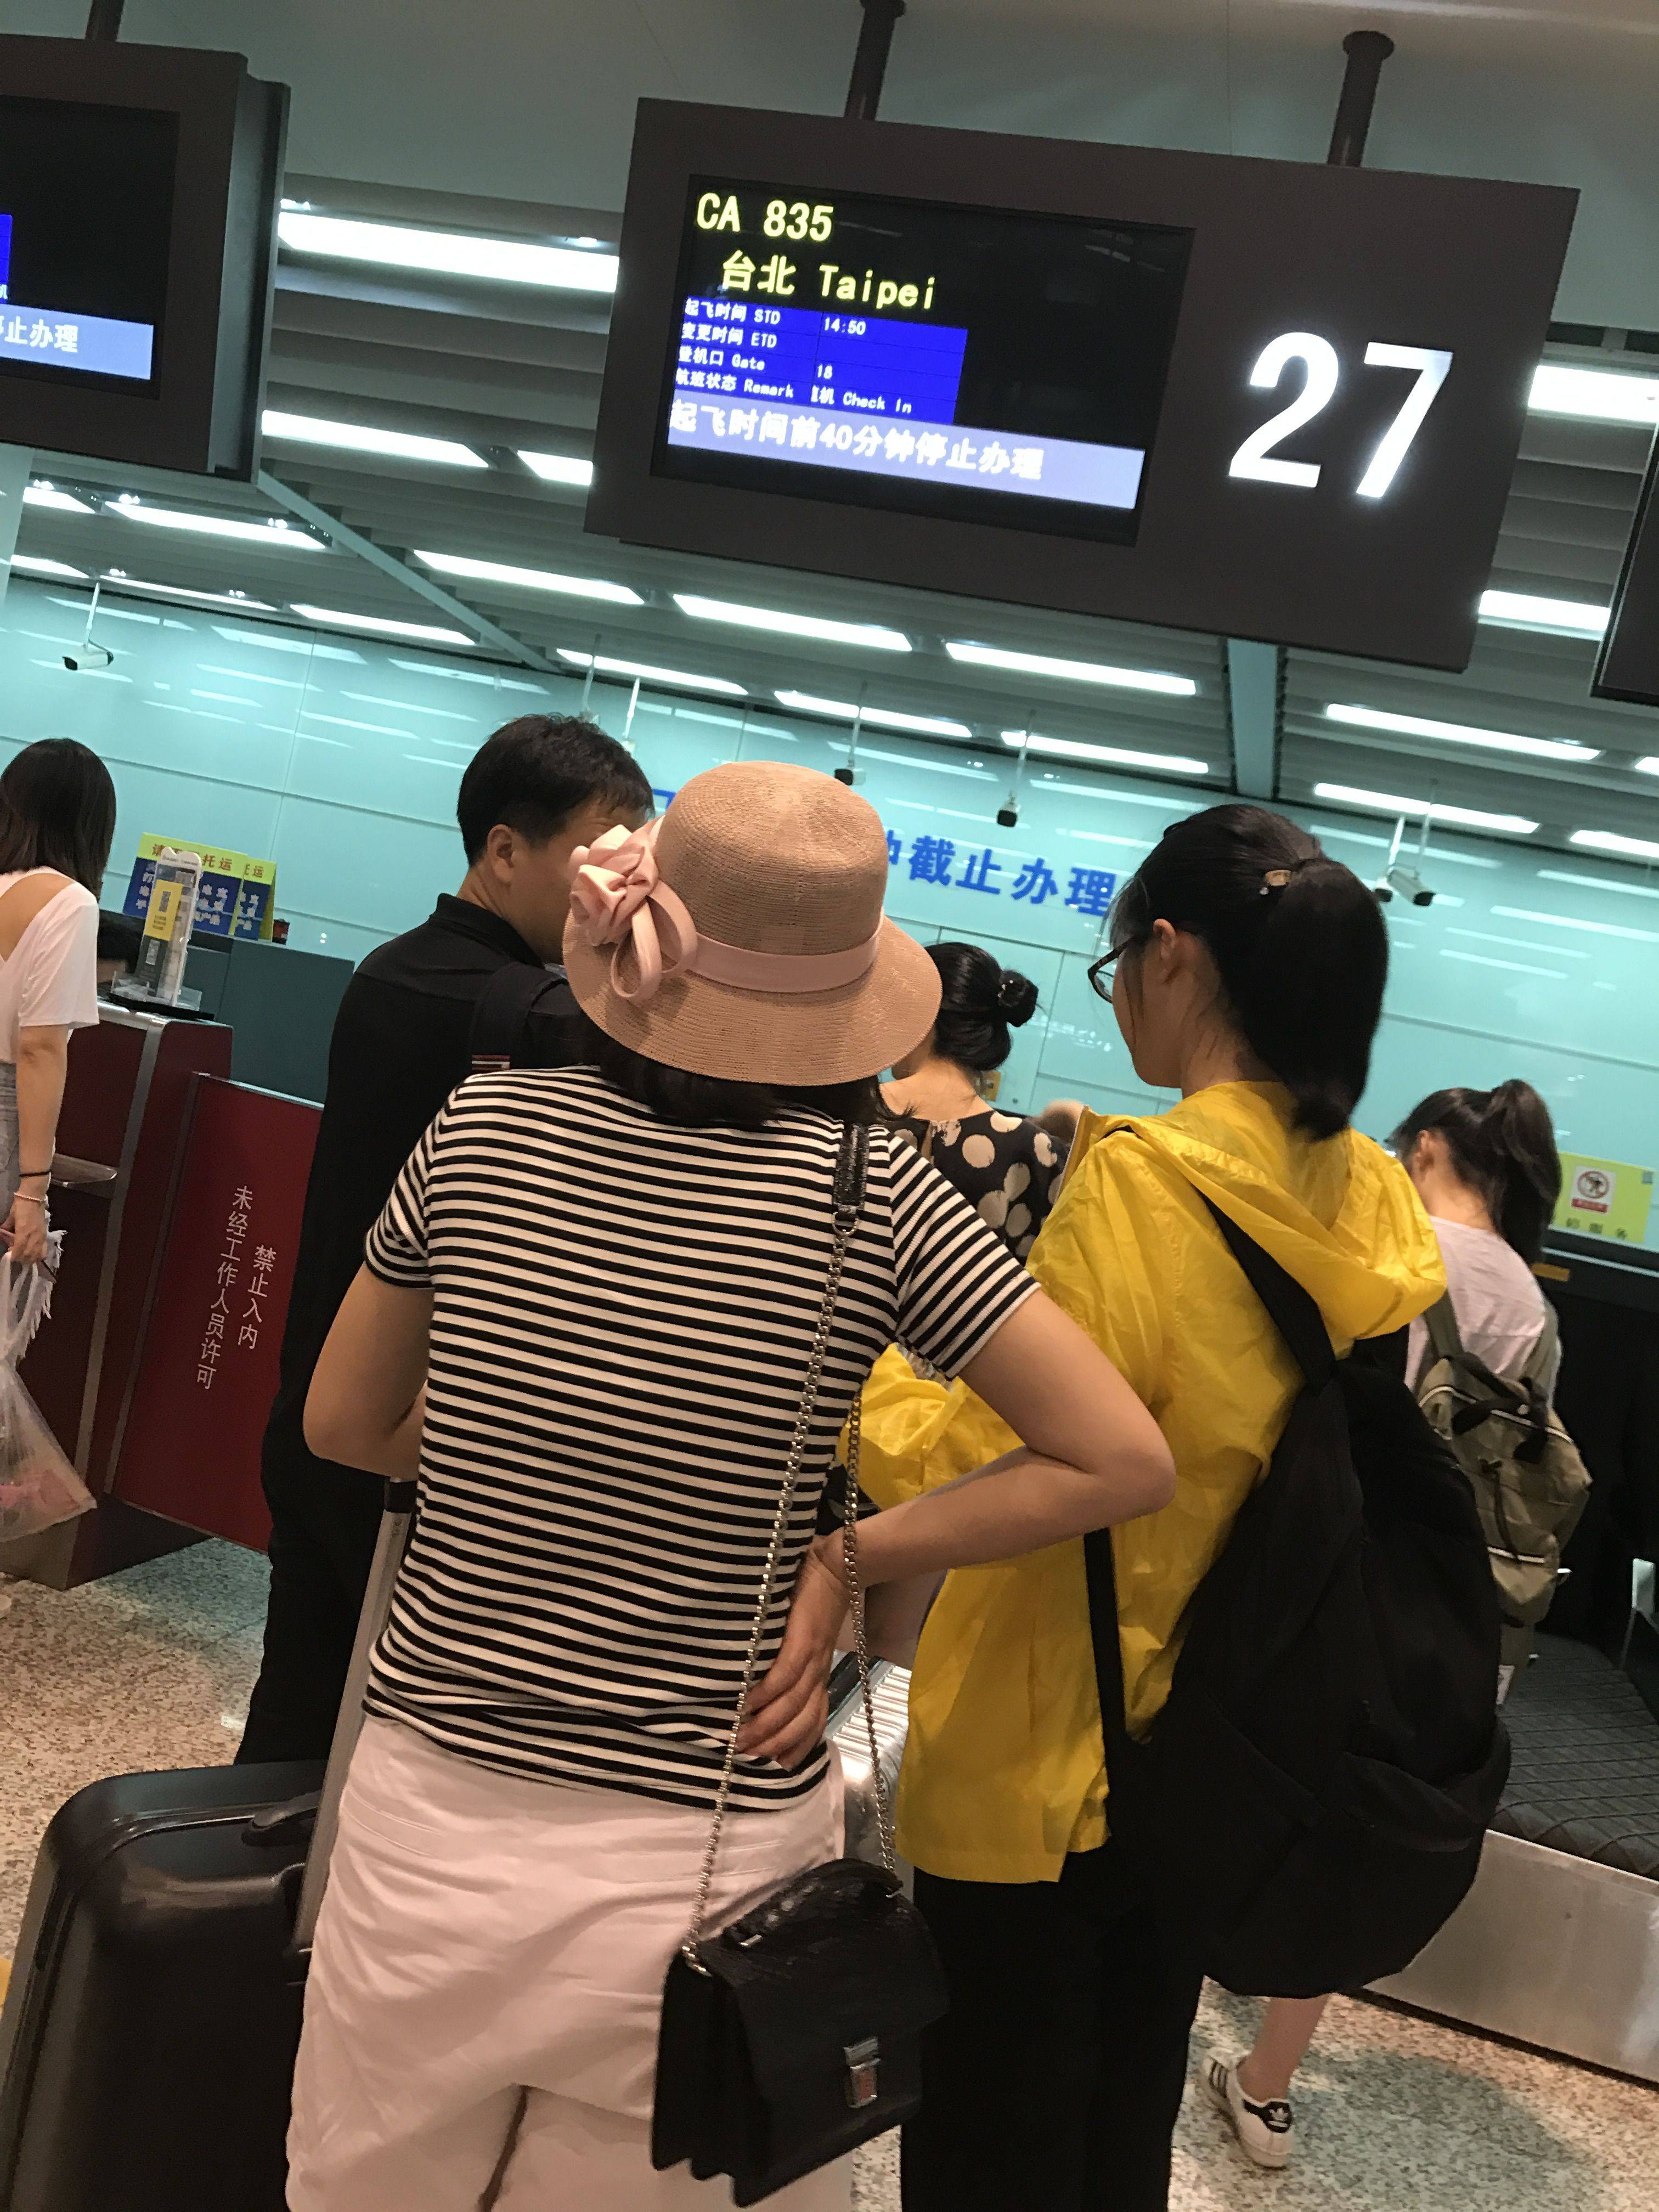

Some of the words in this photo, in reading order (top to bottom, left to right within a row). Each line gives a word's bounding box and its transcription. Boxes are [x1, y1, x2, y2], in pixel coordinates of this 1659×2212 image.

[696, 192, 741, 232] CA
[763, 200, 834, 241] 835
[721, 249, 797, 295] 台北
[819, 263, 935, 309] Taipei
[681, 321, 744, 346] 变更时间
[751, 331, 777, 348] ETD
[685, 297, 747, 323] 起飞时间
[753, 308, 781, 325] STD
[825, 317, 866, 336] 14:50
[678, 345, 724, 366] 登机口
[731, 353, 765, 371] Gate
[817, 364, 833, 379] 18
[675, 367, 737, 392] 航班状态
[743, 378, 794, 398] Remark
[843, 391, 885, 410] Check
[895, 397, 912, 414] In
[1228, 331, 1453, 498] 27
[669, 399, 1045, 480] 起飞时间前40分钟停止办理
[197, 1185, 253, 1390] 未经工作人员许可
[238, 1244, 276, 1350] 禁止入内
